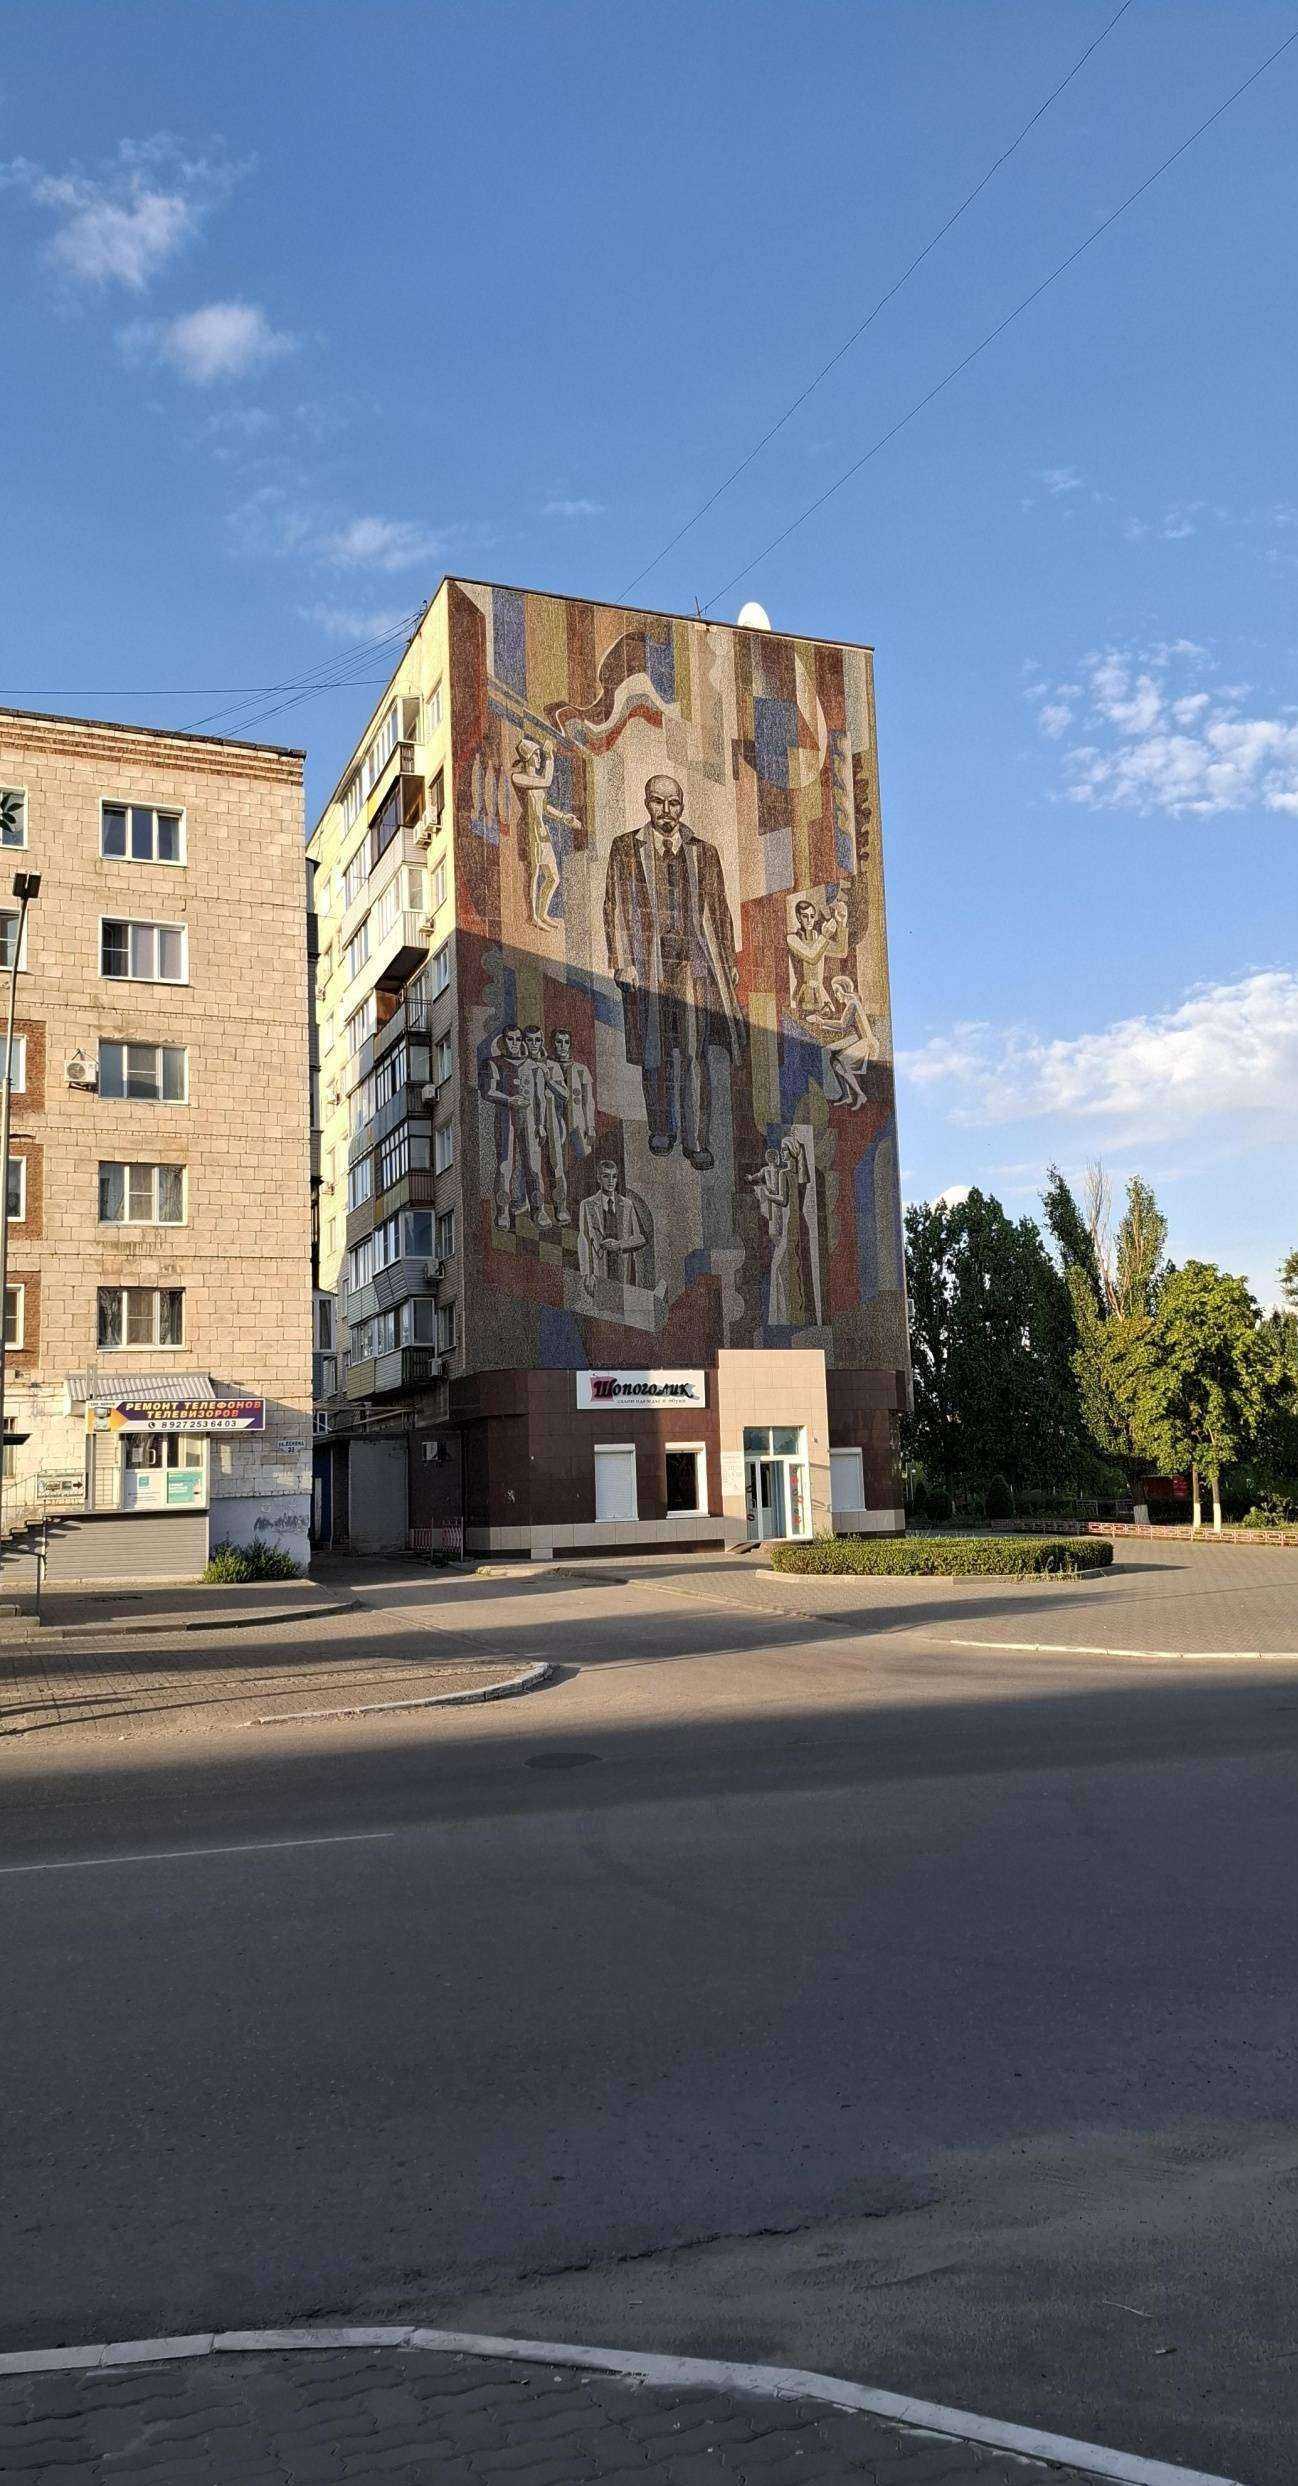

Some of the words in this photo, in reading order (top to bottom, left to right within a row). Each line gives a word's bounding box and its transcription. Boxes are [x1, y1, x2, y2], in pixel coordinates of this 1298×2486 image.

[593, 1378, 694, 1399] Шопоголик
[126, 1402, 179, 1411] РЕМОНТ
[184, 1401, 261, 1410] ТЕЛЕФОНОВ
[147, 1409, 239, 1419] ТЕЛЕВИЗОРОВ
